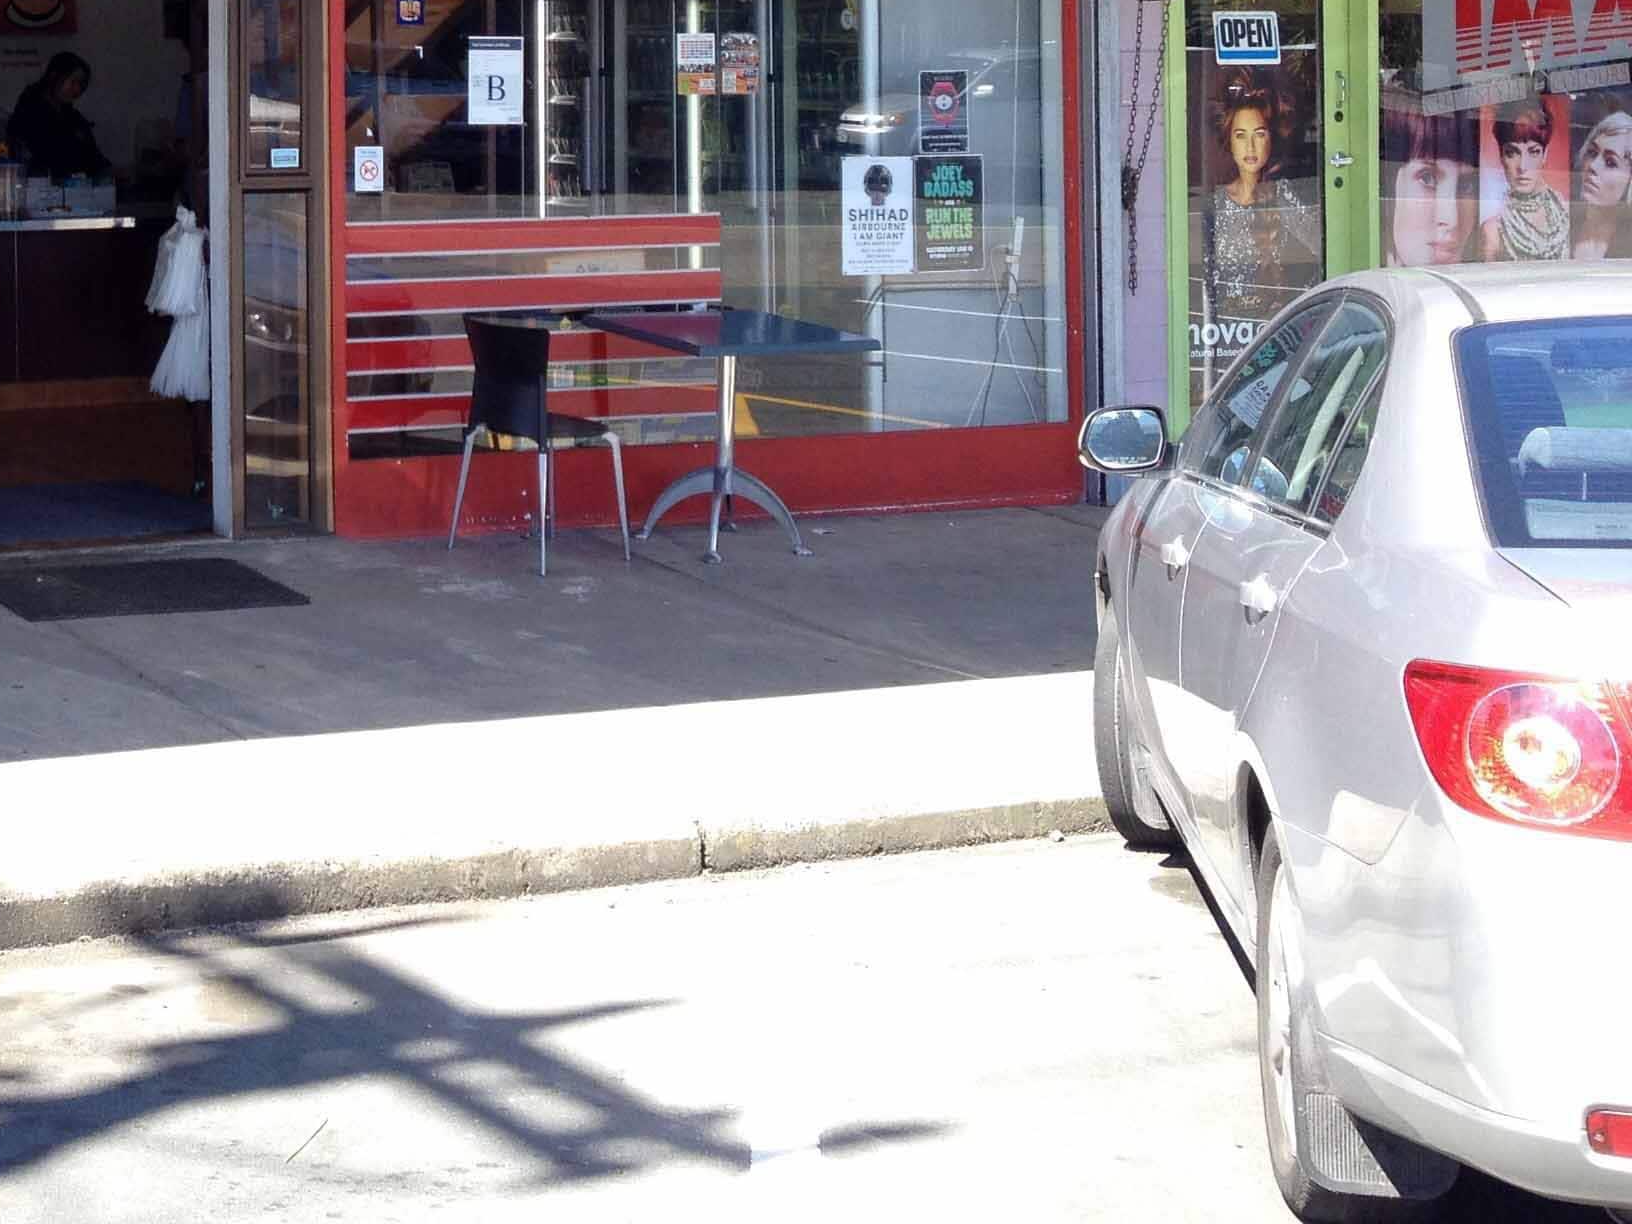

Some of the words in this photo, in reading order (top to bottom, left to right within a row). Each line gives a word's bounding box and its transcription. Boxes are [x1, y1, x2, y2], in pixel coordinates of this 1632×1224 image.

[1219, 18, 1273, 48] OPEN
[487, 74, 506, 101] B
[931, 164, 964, 182] JOEY
[848, 208, 909, 222] SHIHAD
[925, 207, 952, 225] RUN
[953, 207, 974, 224] THE
[926, 224, 974, 241] JEWELS
